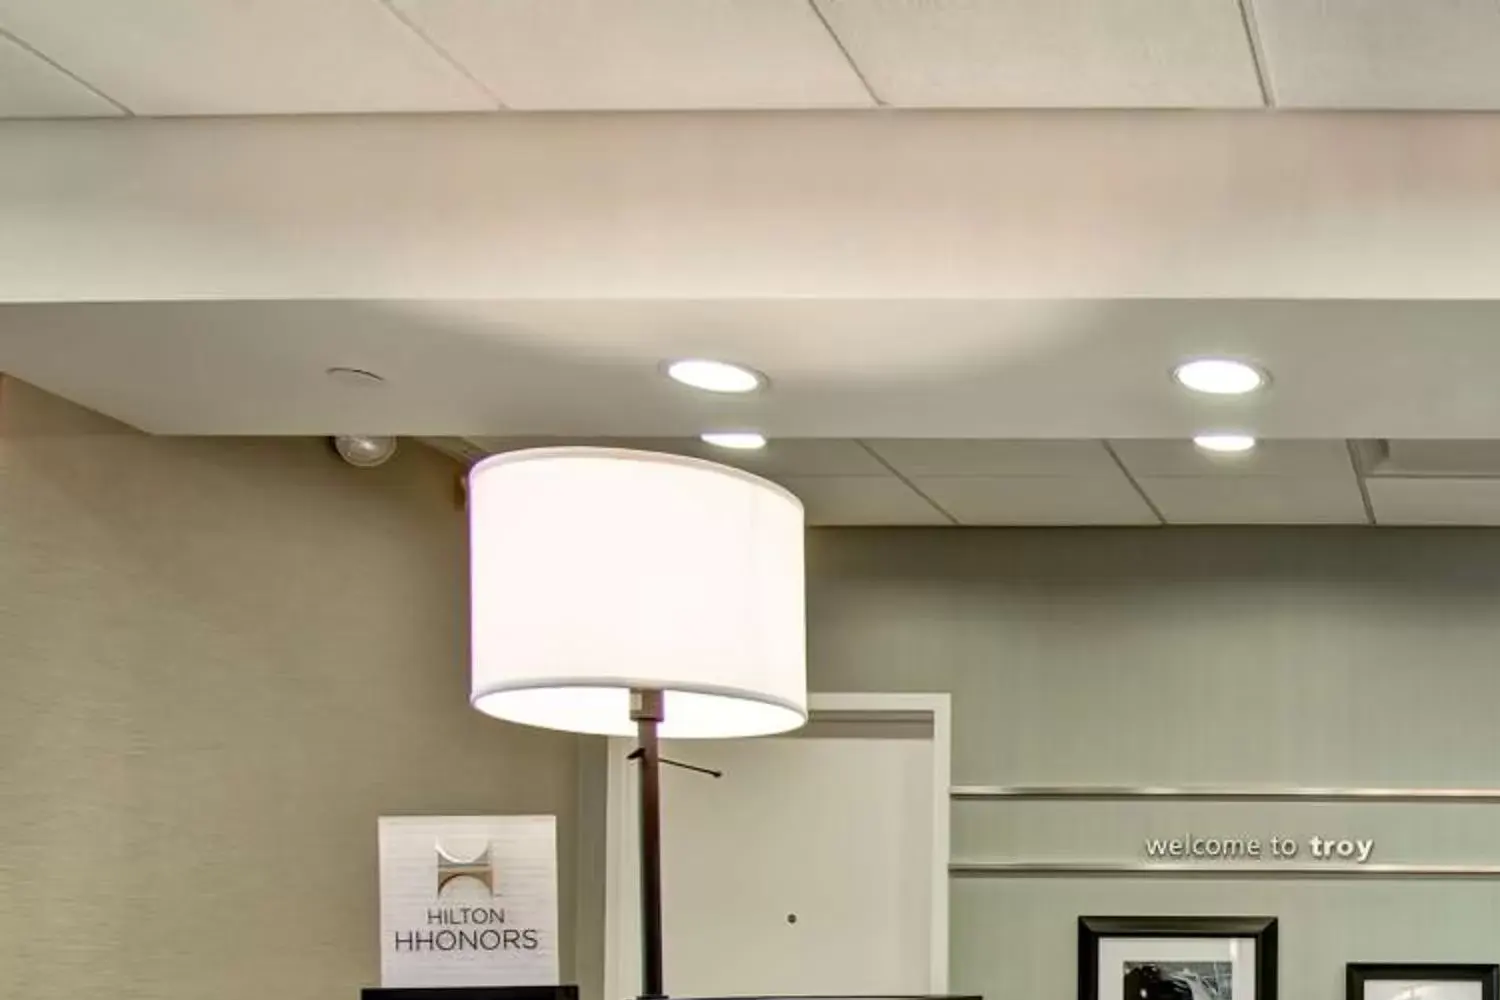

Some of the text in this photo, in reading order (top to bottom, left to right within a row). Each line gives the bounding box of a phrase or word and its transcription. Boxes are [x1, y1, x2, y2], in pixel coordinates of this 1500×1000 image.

[1146, 832, 1374, 862] welcome to troy
[427, 907, 506, 925] HILTON
[395, 929, 539, 951] HHONORS
